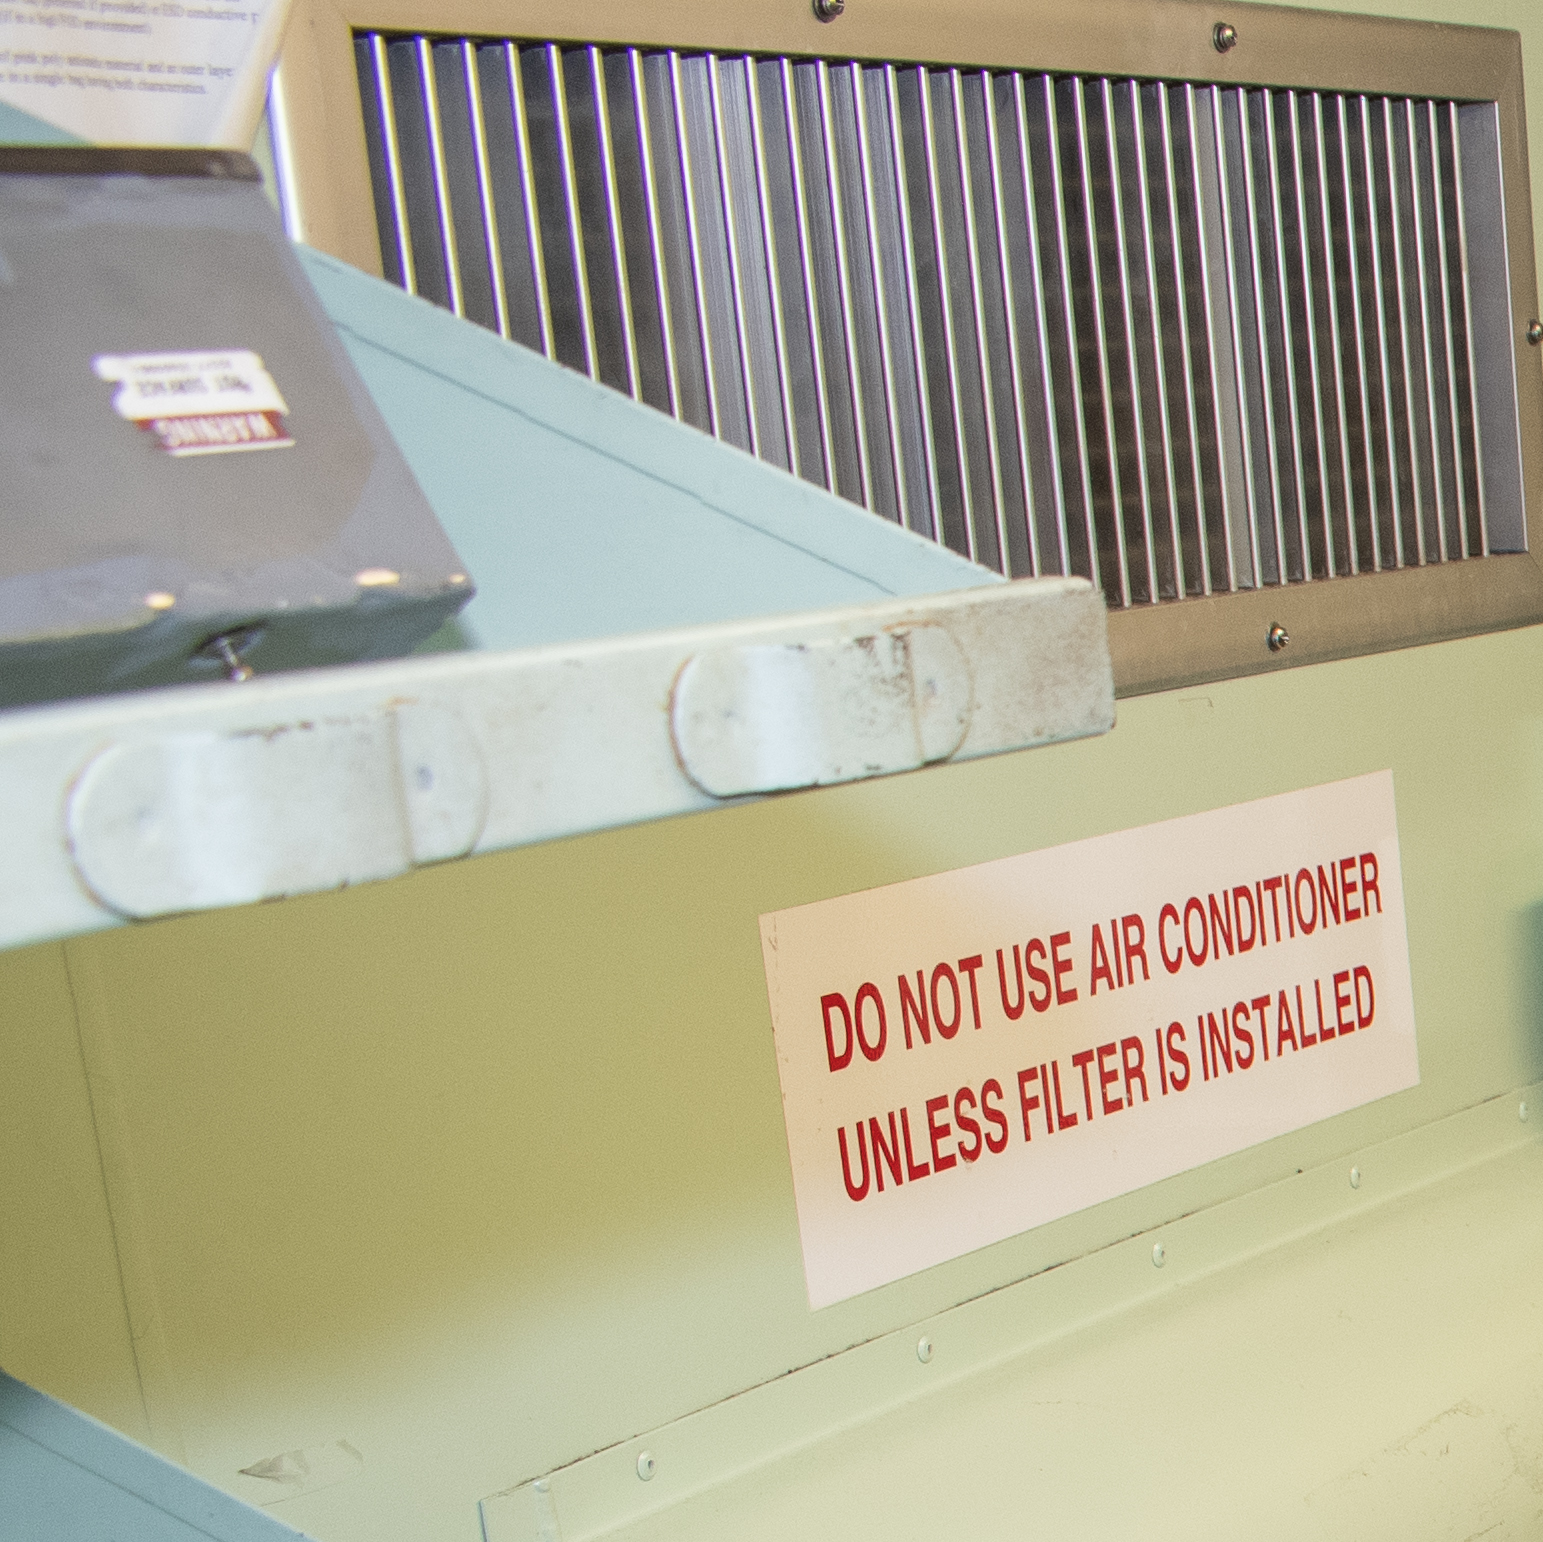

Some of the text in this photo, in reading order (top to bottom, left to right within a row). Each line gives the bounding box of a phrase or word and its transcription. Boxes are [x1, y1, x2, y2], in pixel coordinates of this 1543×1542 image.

[820, 851, 1384, 1073] DO NOT USE AIR CONDITIONER
[837, 964, 1376, 1203] UNLESS FILTER IS INSTALLED
